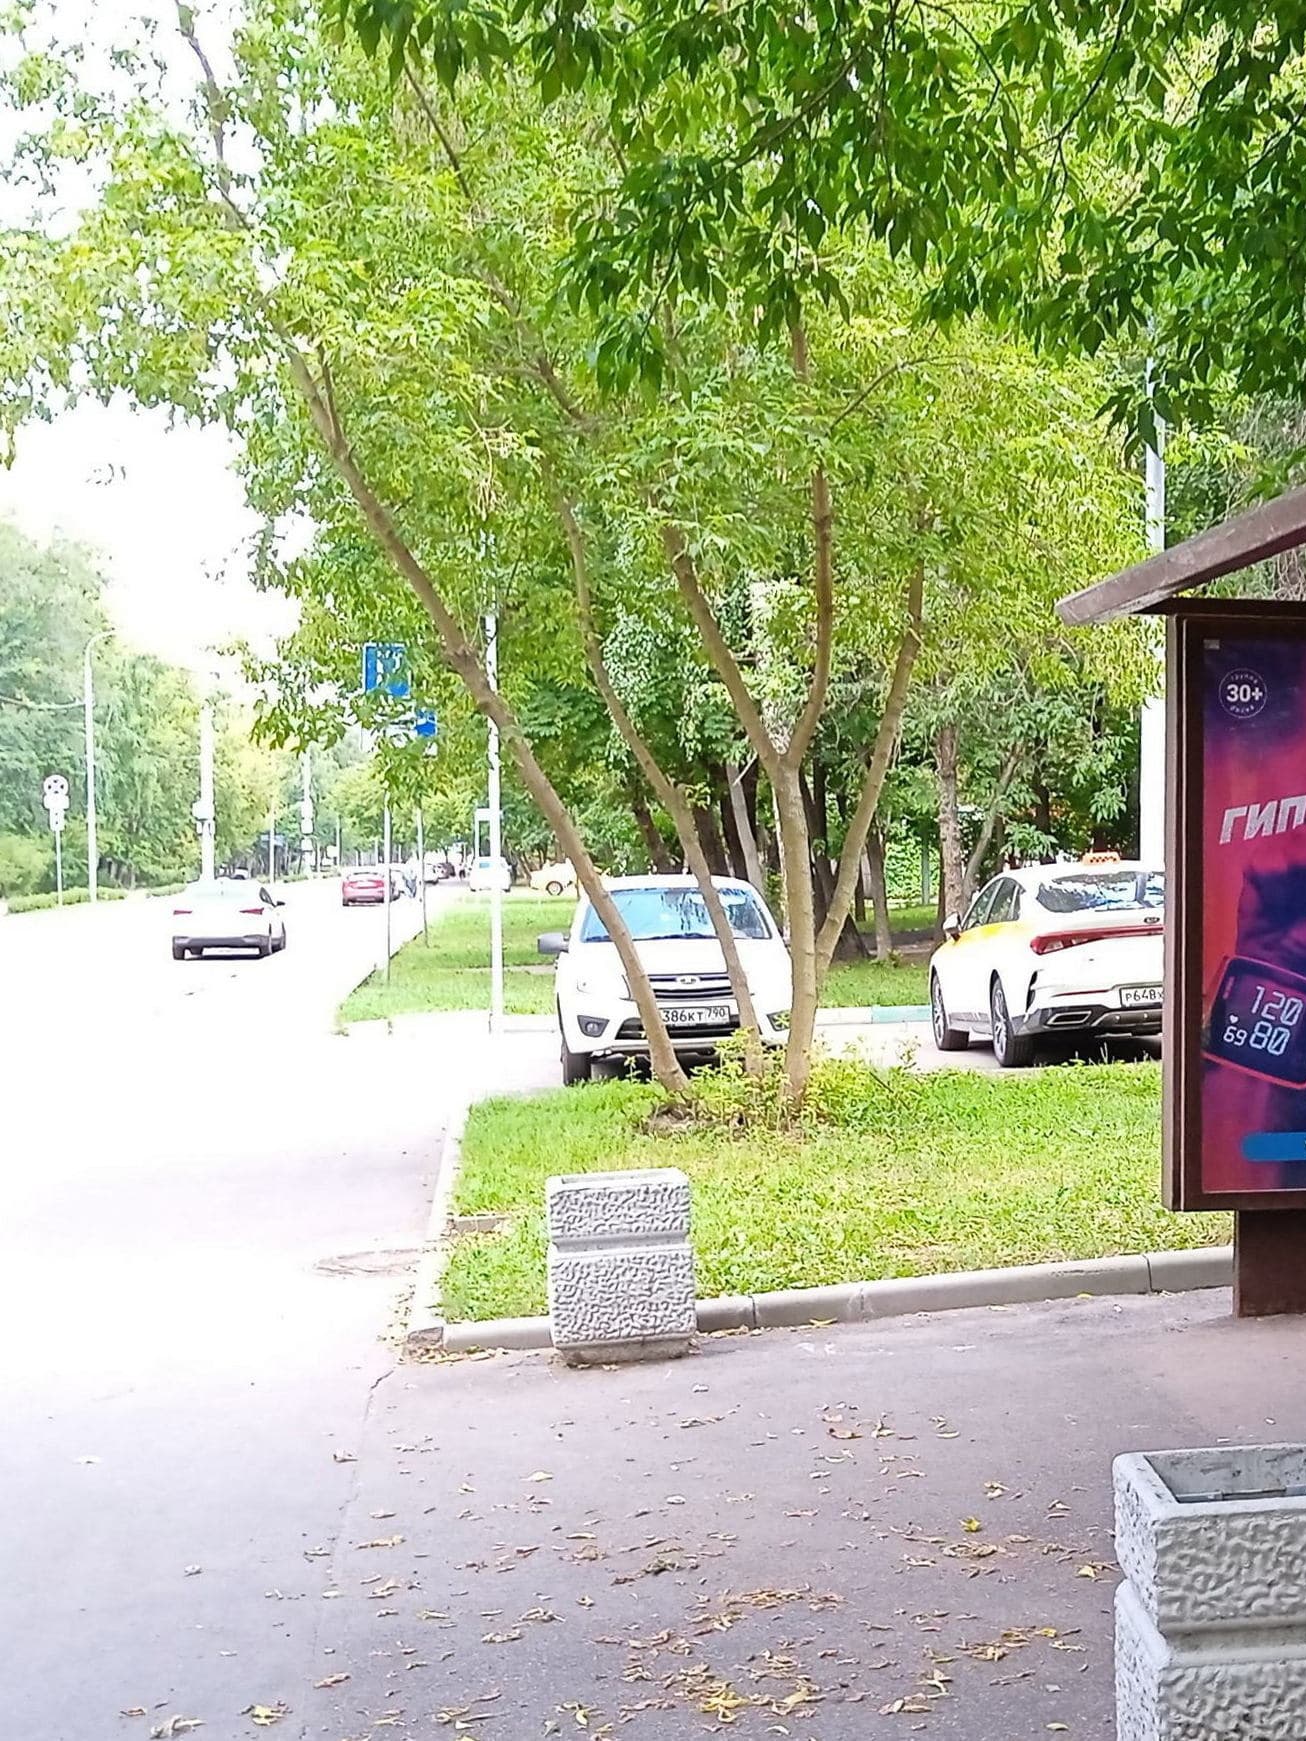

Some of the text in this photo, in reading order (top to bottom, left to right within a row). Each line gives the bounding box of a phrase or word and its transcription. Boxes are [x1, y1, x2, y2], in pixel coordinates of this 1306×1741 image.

[1226, 684, 1263, 702] 30+
[662, 1010, 704, 1022] 386КТ
[1251, 985, 1303, 1026] 120
[1223, 1025, 1248, 1046] 69
[1249, 1020, 1291, 1056] 80
